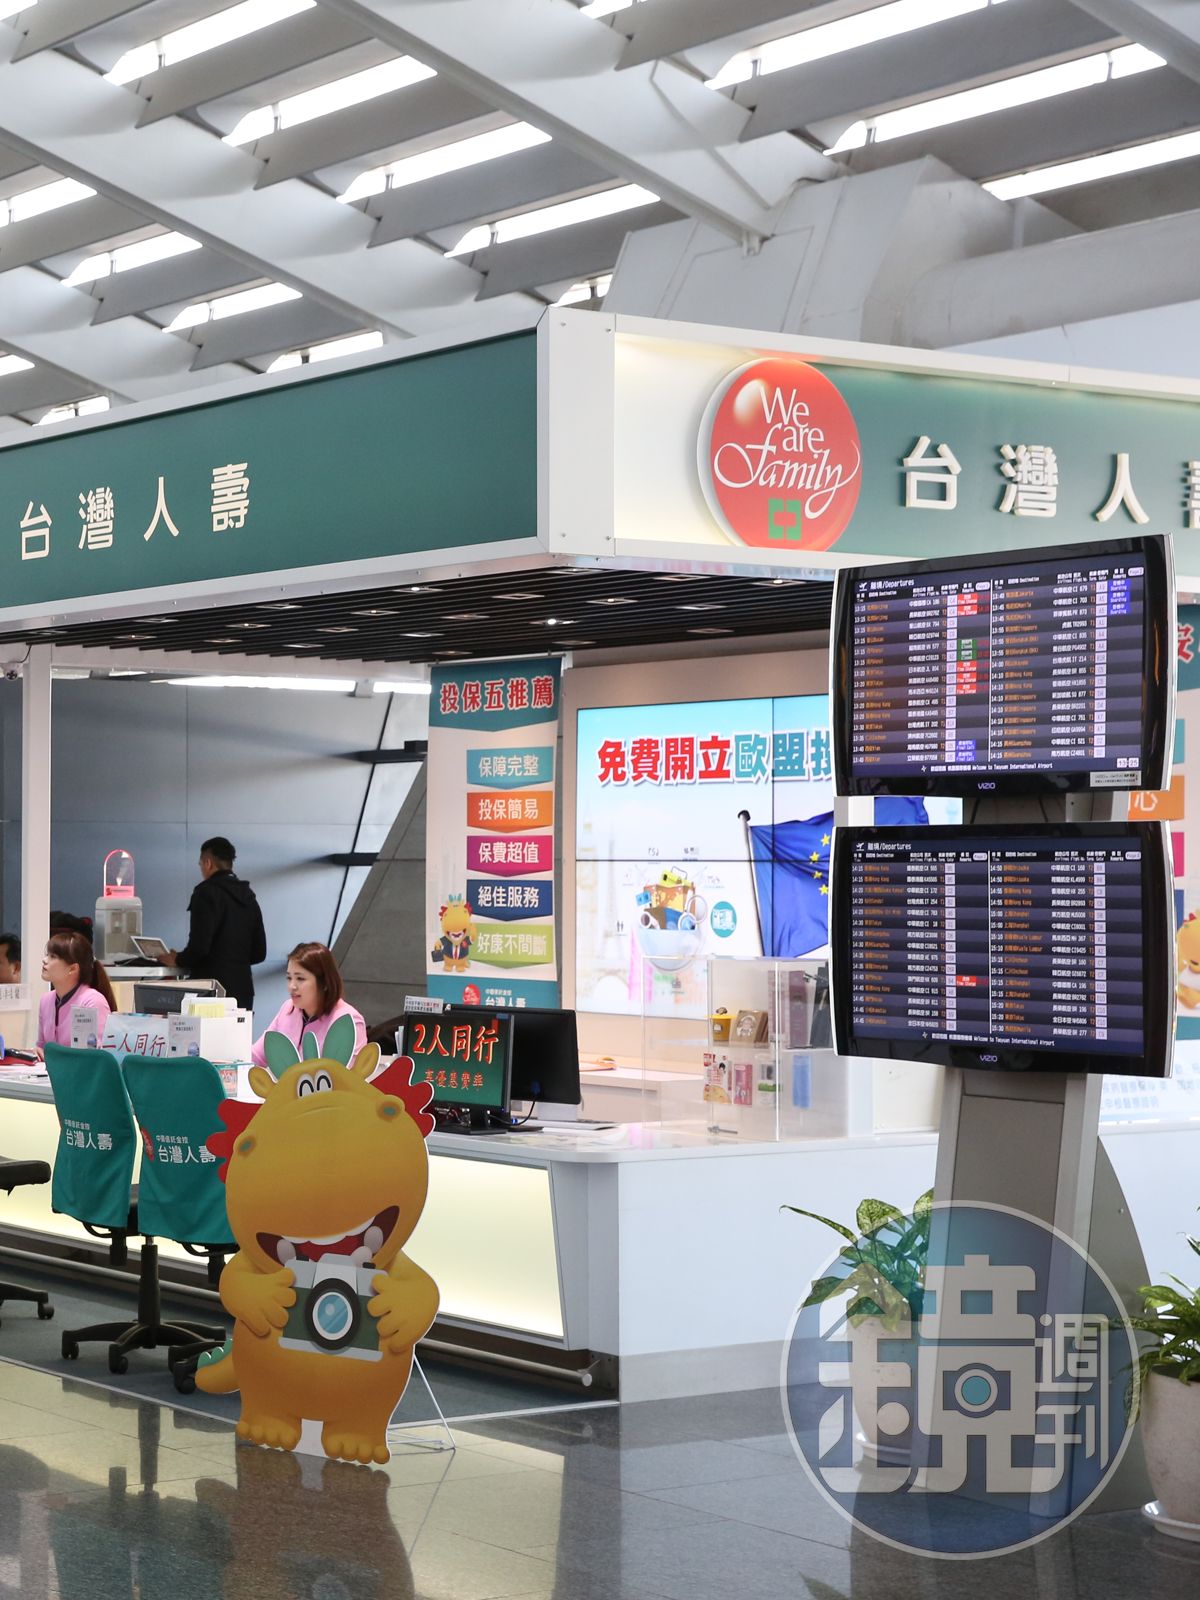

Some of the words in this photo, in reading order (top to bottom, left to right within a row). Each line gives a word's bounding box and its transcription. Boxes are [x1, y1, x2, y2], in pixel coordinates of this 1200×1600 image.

[761, 386, 810, 428] We
[782, 423, 824, 453] are
[713, 423, 861, 520] Family
[903, 434, 1200, 529] 台灣人
[19, 461, 250, 562] 台灣人壽
[440, 674, 555, 714] 投保五推薦
[478, 752, 540, 778] 保障完整
[977, 782, 996, 790] VIZIO
[478, 797, 539, 822] 投保簡易
[478, 841, 540, 865] 保費超值
[477, 884, 540, 909] 絕佳服務
[476, 931, 547, 957] 好康不間斷
[102, 1032, 166, 1057] 二人同行
[413, 1023, 500, 1065] 2人同行
[65, 1129, 113, 1151] 台灣人壽
[158, 1145, 217, 1164] 台灣人壽
